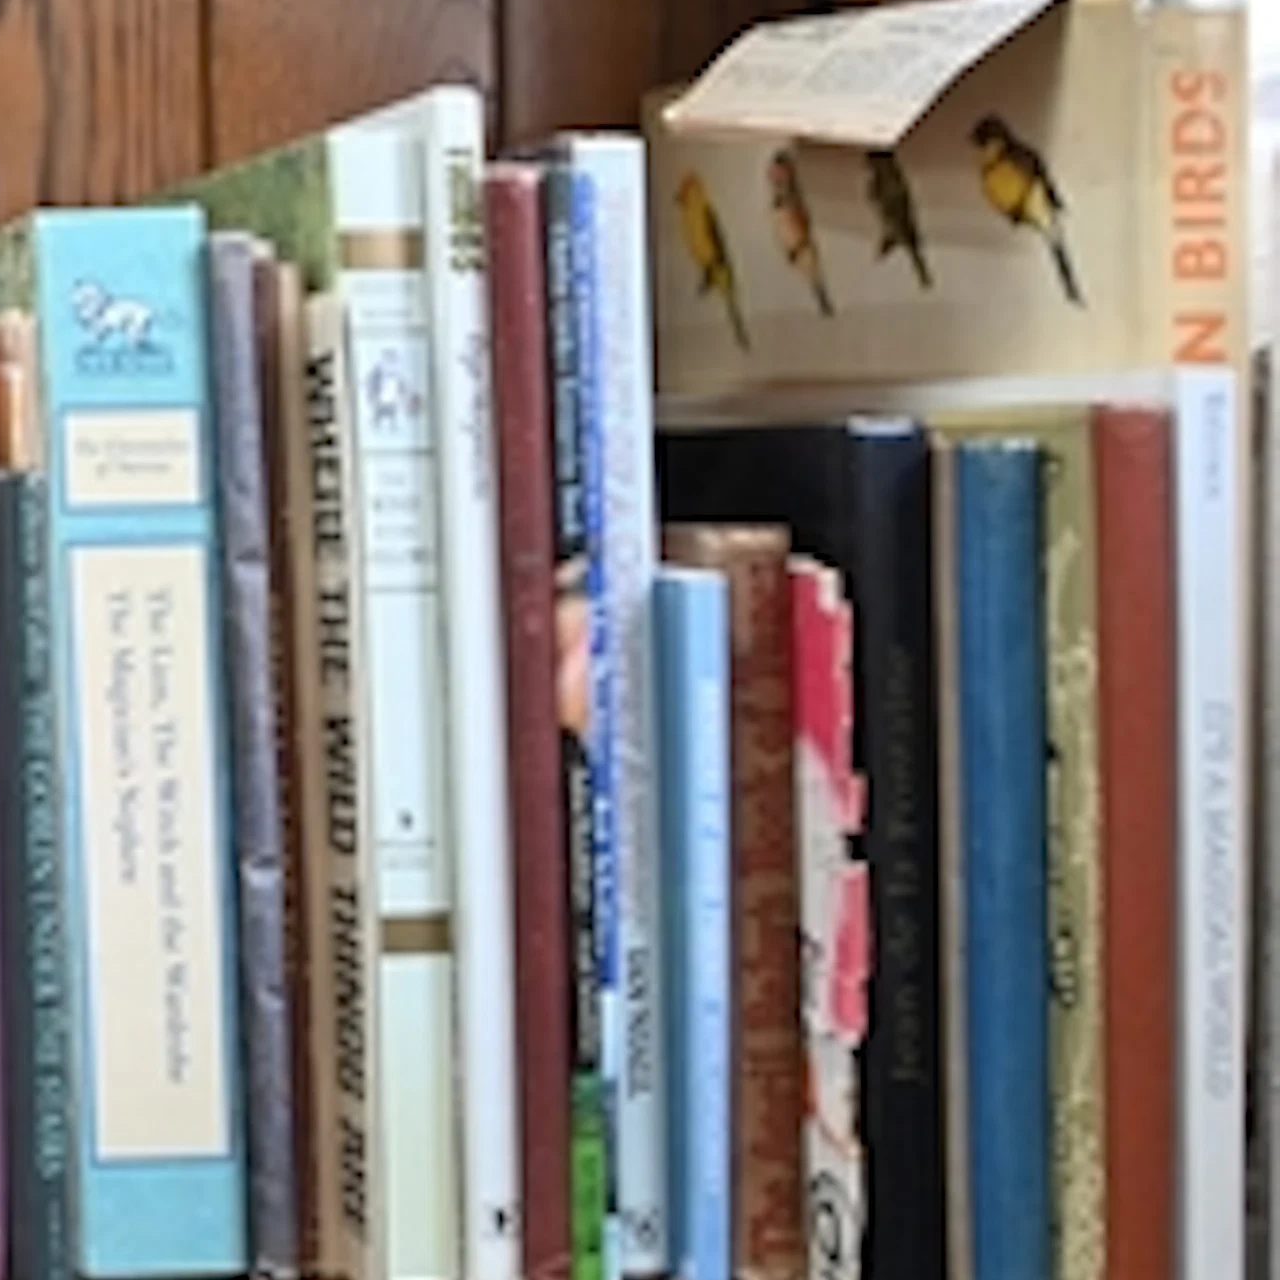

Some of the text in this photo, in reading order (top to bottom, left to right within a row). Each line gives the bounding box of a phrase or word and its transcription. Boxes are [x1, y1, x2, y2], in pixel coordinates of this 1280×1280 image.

[1172, 69, 1227, 281] BIRDS
[105, 587, 139, 885] The Magician's Nephew
[304, 350, 368, 1240] WHERE THE WILD THINGS ARE
[24, 761, 59, 883] GOBLIN
[147, 587, 191, 1084] The Lion, The Witch and the Wardrobe
[883, 855, 920, 896] la
[886, 911, 923, 961] de
[889, 984, 927, 1086] Jean
